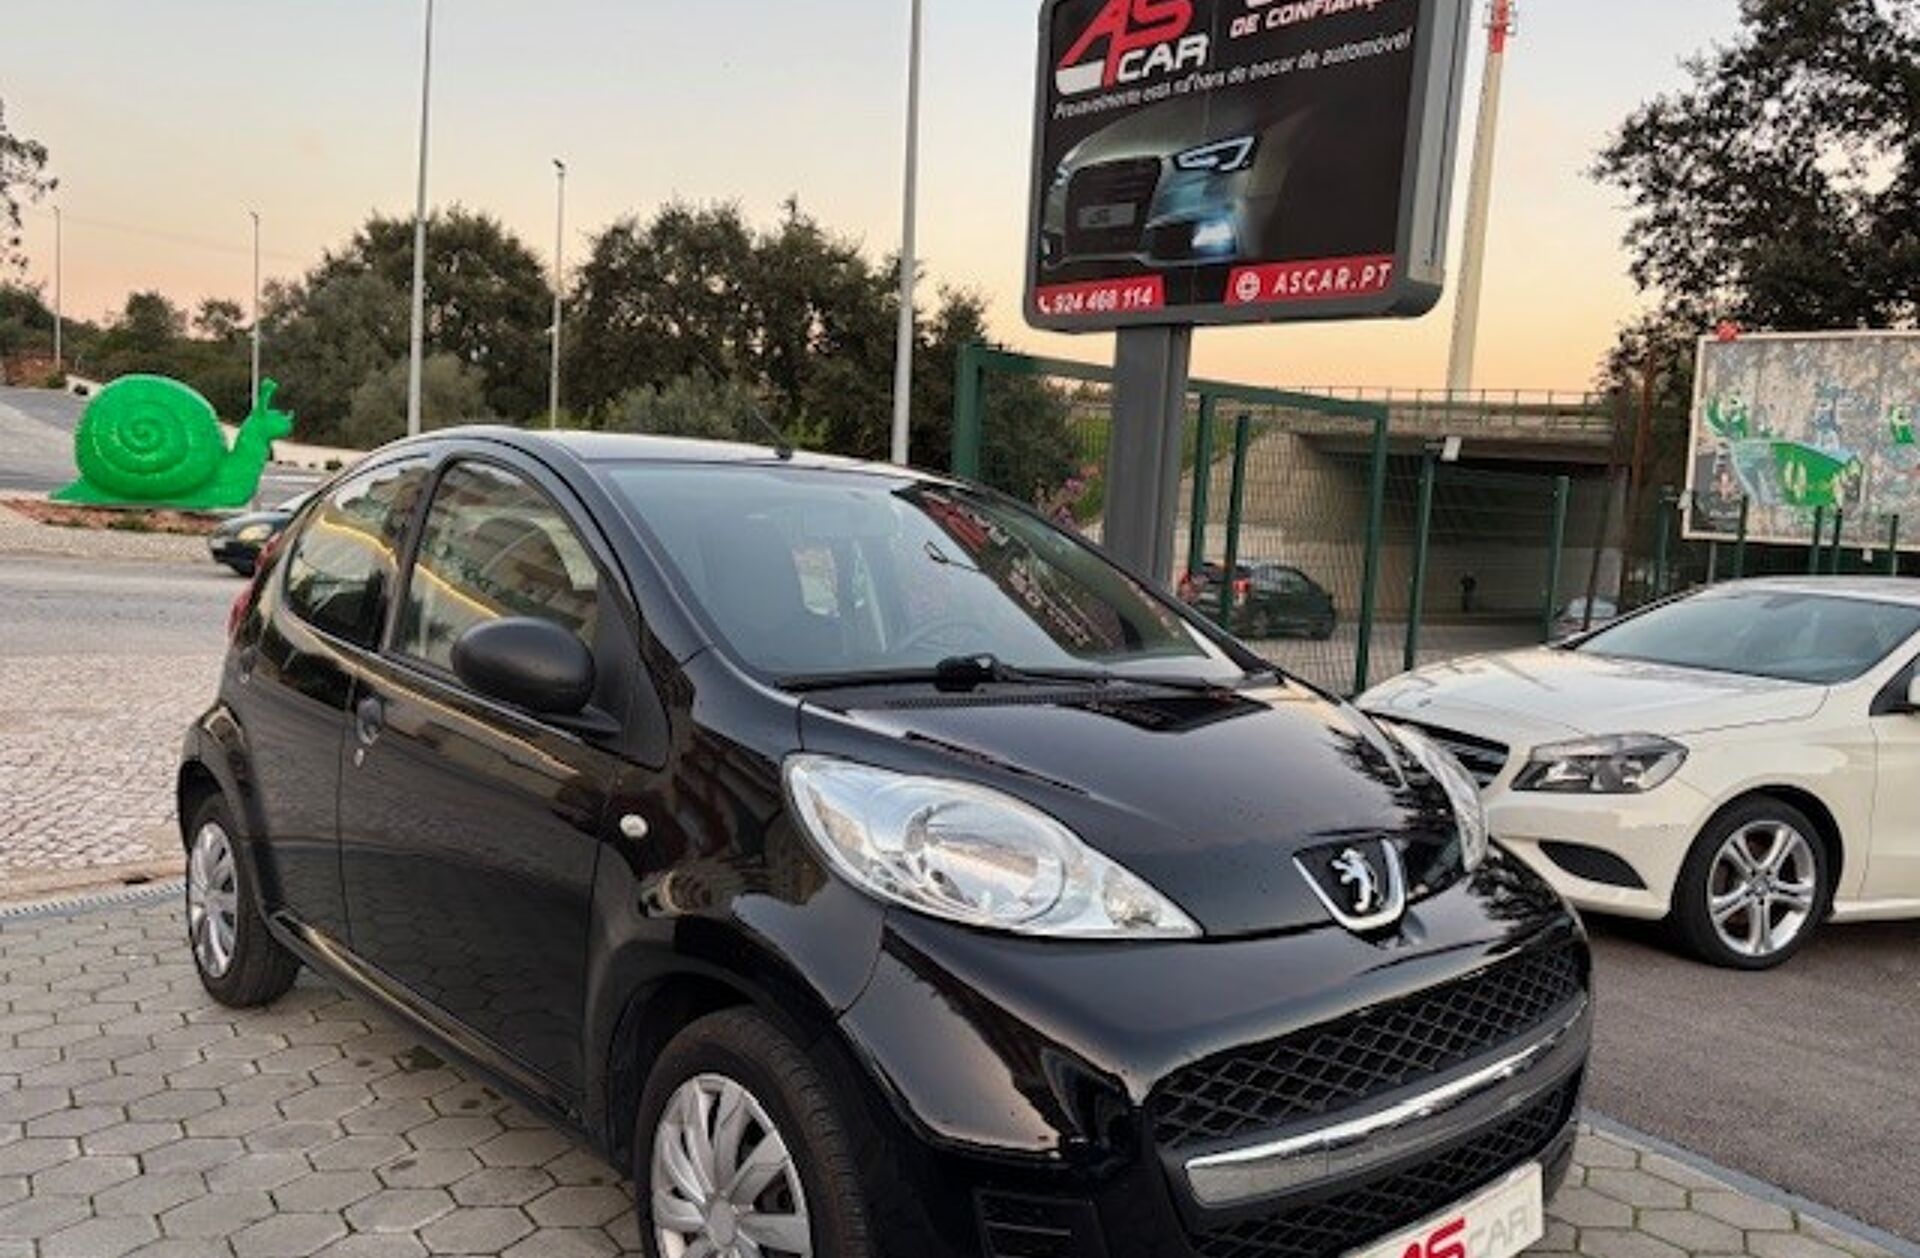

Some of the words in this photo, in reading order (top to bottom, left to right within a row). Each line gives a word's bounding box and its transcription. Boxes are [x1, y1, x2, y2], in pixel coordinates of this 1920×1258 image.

[1229, 13, 1260, 38] DE
[1117, 33, 1210, 83] CAR
[1227, 65, 1247, 84] de
[1250, 55, 1297, 81] trocar
[1299, 49, 1320, 70] de
[1272, 262, 1392, 295] ASCAR.PT
[1122, 286, 1153, 308] 114
